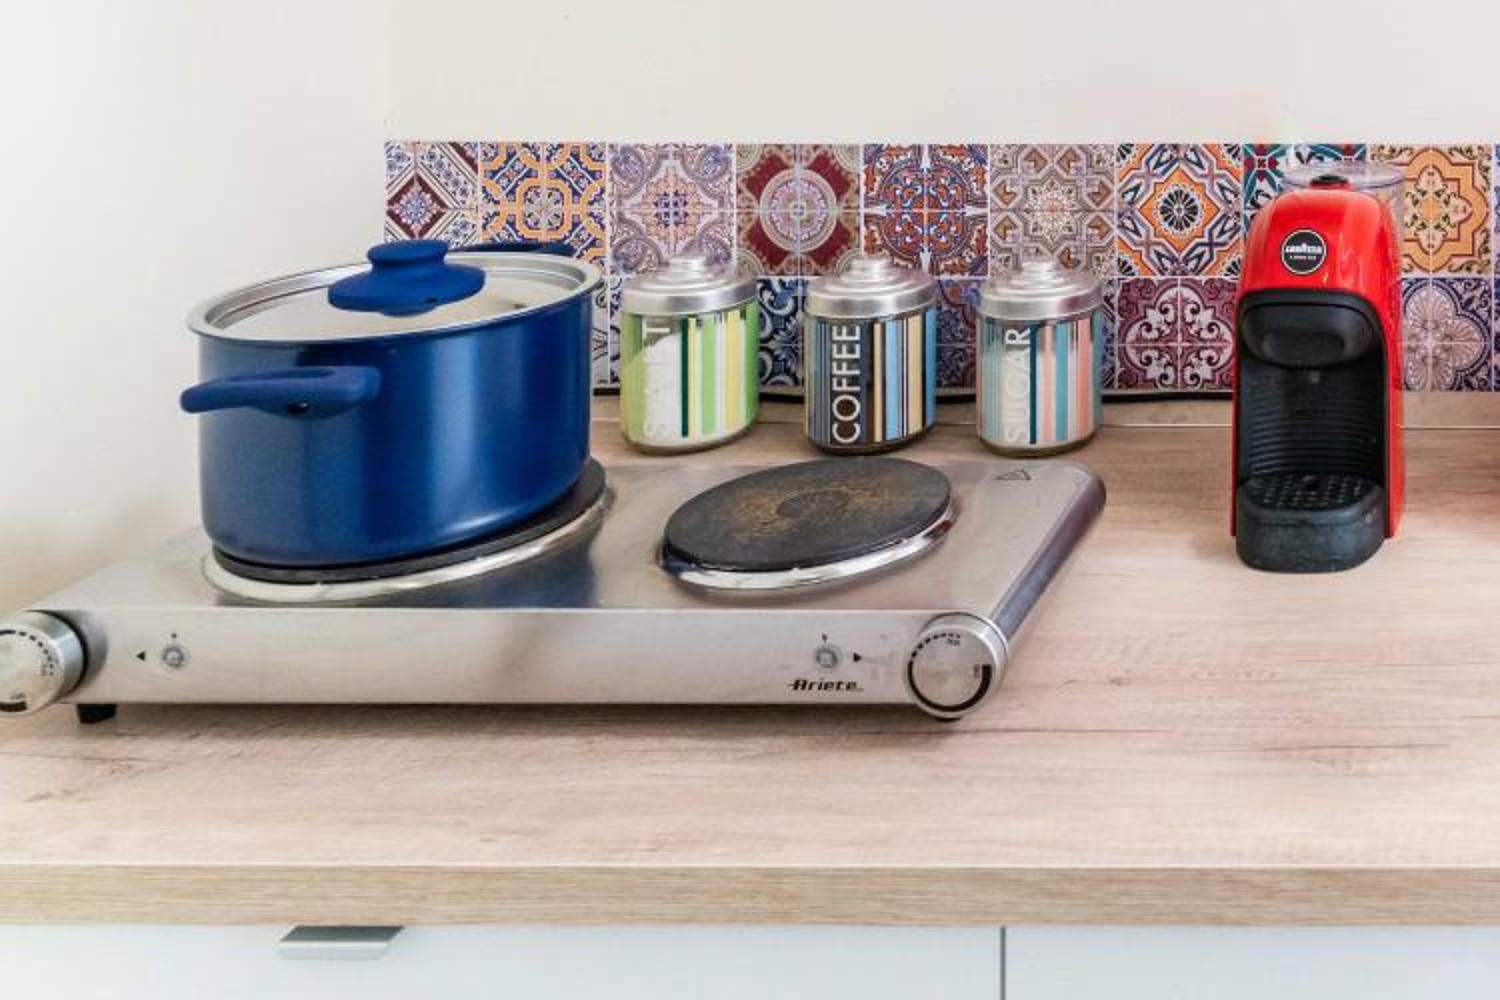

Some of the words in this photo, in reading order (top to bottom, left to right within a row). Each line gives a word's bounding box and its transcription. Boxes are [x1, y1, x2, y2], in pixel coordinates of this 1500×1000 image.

[832, 325, 861, 444] COFFEE
[1004, 327, 1030, 443] SUGAR
[789, 679, 862, 692] Ariete
